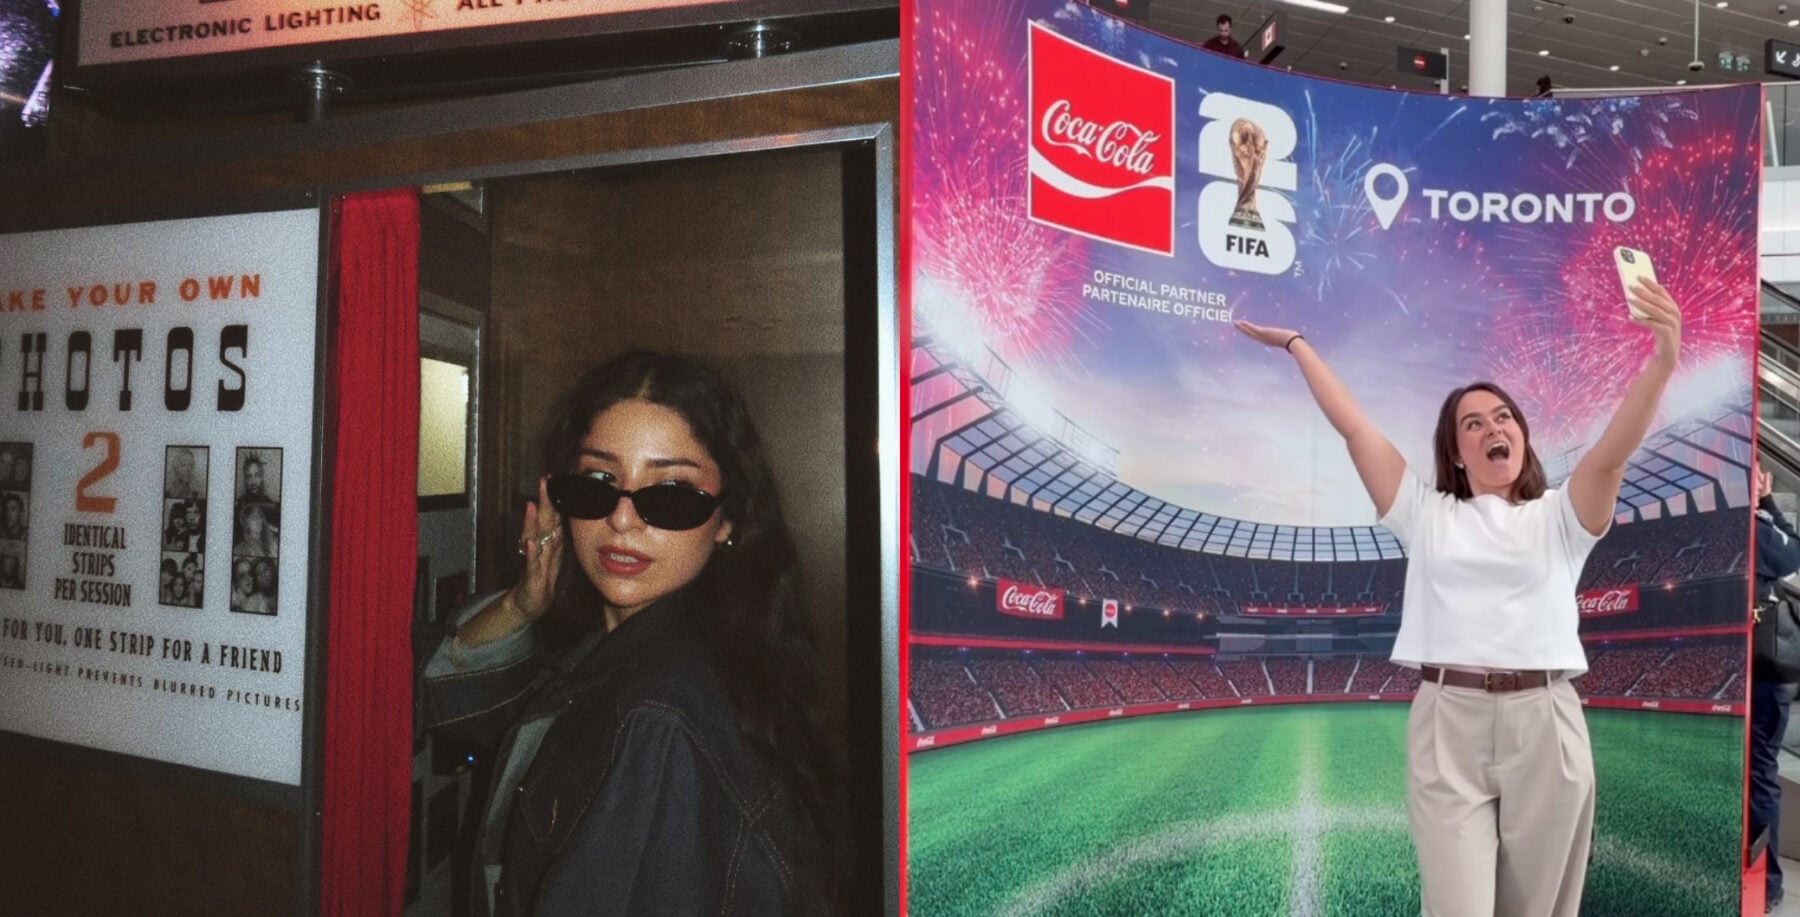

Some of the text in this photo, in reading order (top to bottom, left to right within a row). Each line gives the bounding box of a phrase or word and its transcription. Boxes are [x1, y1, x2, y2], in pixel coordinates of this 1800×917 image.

[109, 3, 381, 48] ELECTRONIC LIGHTING
[1041, 99, 1161, 176] Coca-Cola
[1422, 188, 1636, 224] TORONTO
[1225, 234, 1270, 258] FIFA
[0, 273, 261, 313] KE YOUR OWN
[1082, 284, 1170, 313] PARTENAIRE
[1093, 270, 1227, 307] OFFICIAL PARTNER
[0, 324, 249, 411] HOTOS
[75, 431, 121, 513] 2
[64, 523, 127, 550] IDENTICAL
[72, 552, 116, 577] STRIPS
[54, 578, 132, 607] PER SESSION
[1002, 585, 1059, 616] Coca-Cola
[1577, 590, 1632, 612] oca-Cola
[2, 618, 282, 674] FOR YOU, ONE STRIP FOR A FRIEND
[78, 667, 143, 688] PREVENTS
[153, 679, 216, 699] BLURRED
[227, 689, 300, 711] PICTURES
